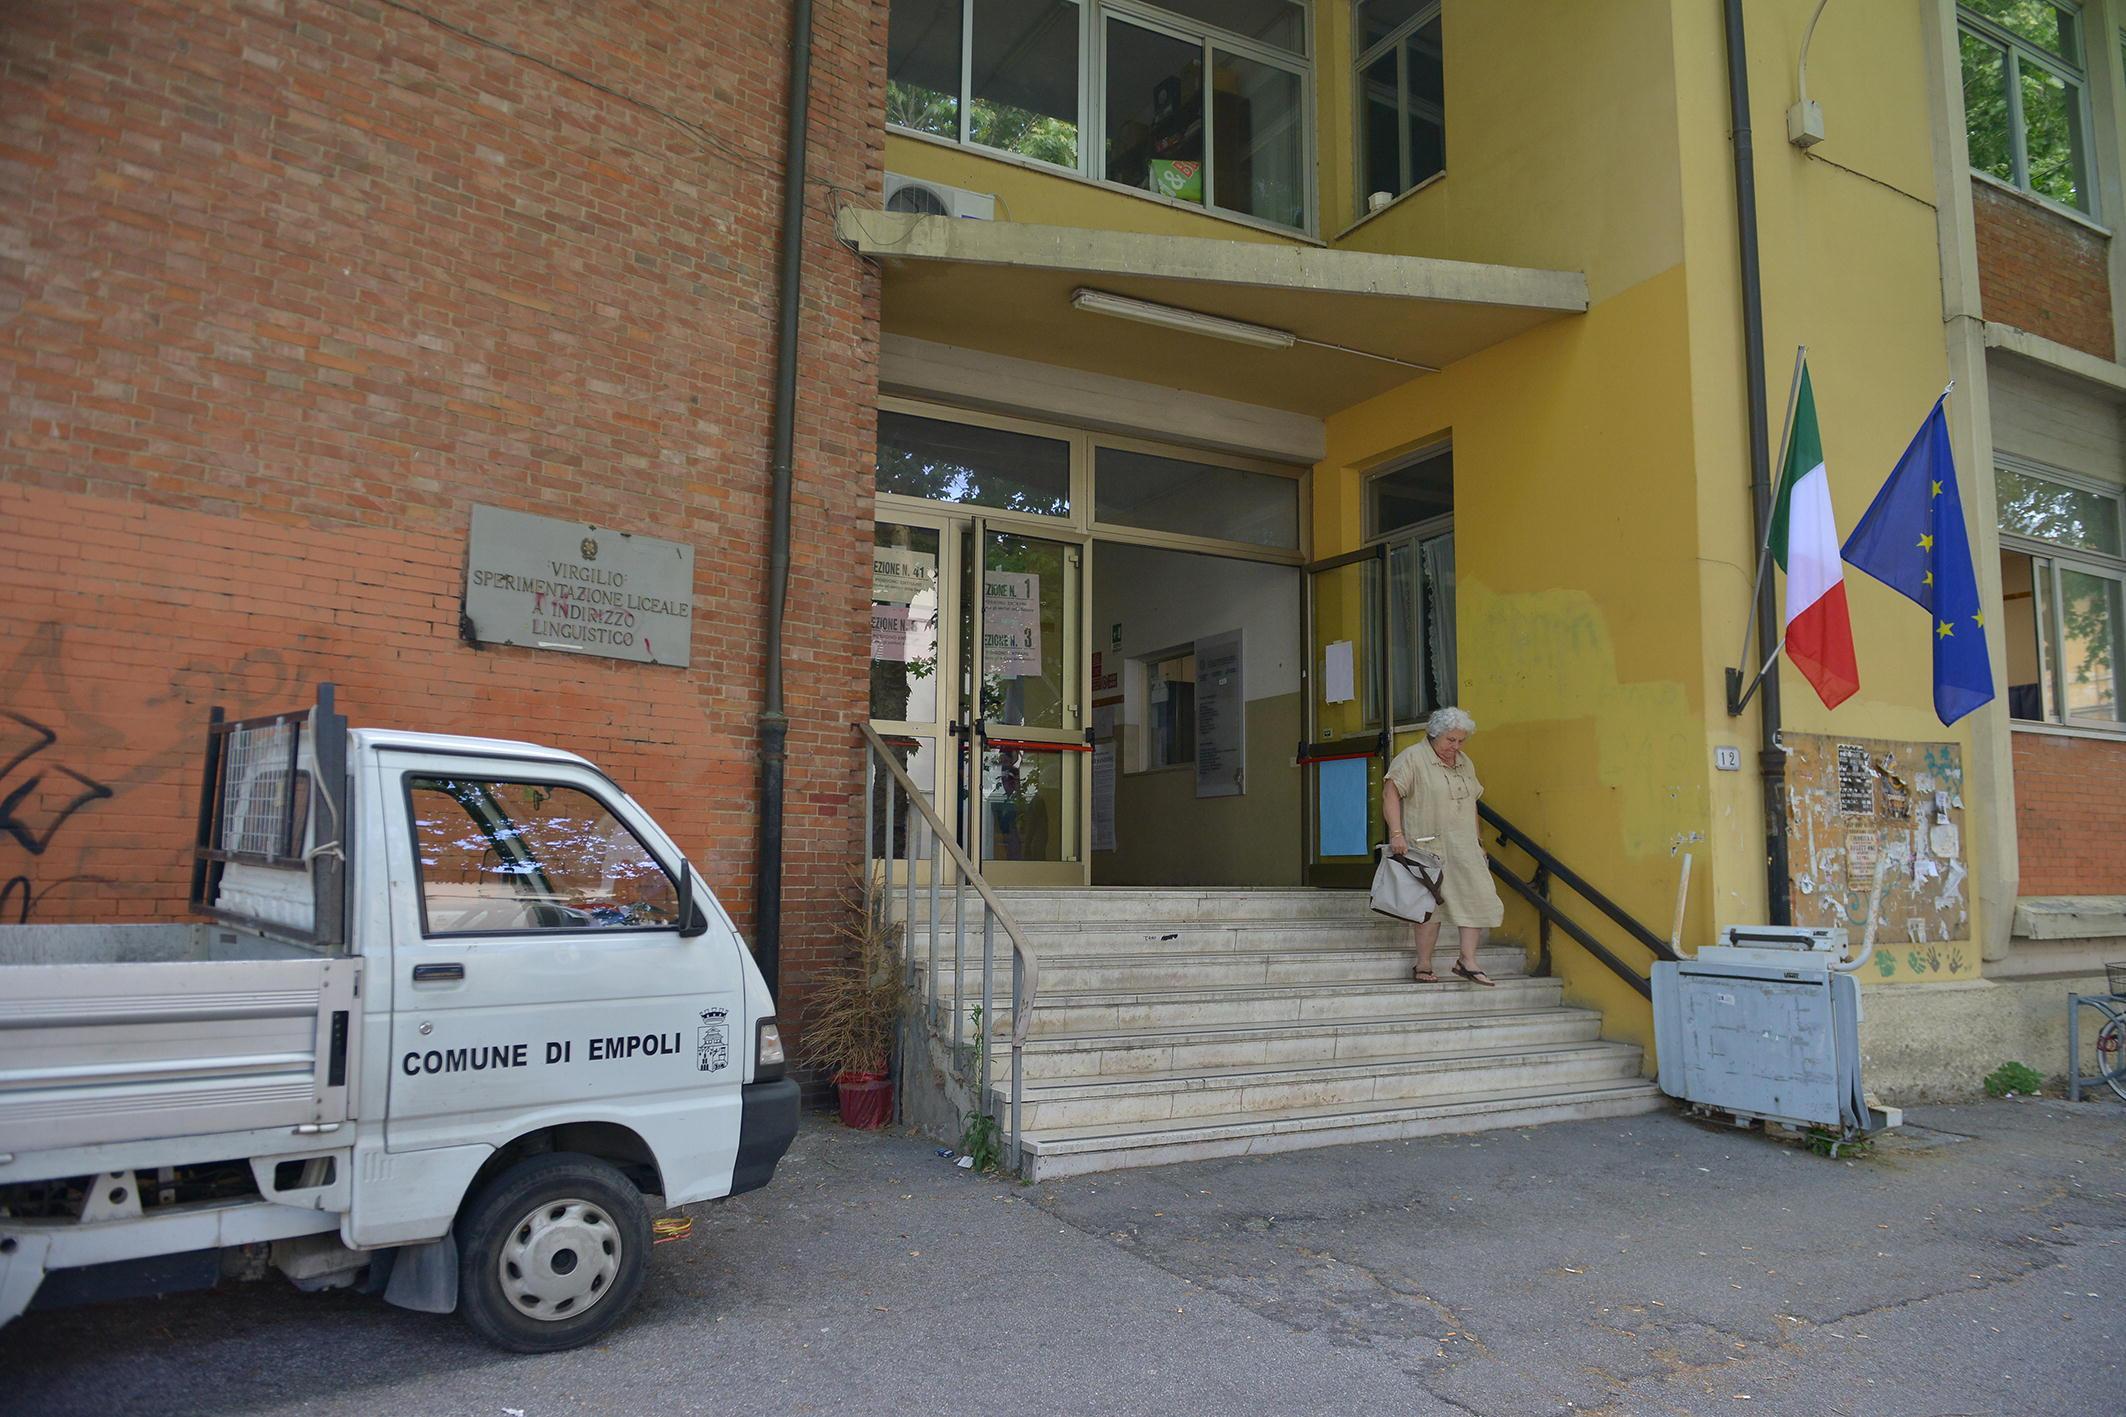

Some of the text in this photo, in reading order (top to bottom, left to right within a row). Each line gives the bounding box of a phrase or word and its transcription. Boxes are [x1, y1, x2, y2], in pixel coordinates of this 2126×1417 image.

[913, 567, 925, 578] 41
[473, 569, 689, 618] SPERIMENTAZIONE LICEALE
[1024, 578, 1030, 599] 1
[552, 602, 635, 628] INDIRIZZO
[532, 619, 633, 647] LINGUISTICO
[1024, 627, 1032, 648] 3
[402, 1032, 681, 1076] COMUNE DI EMPOLI
